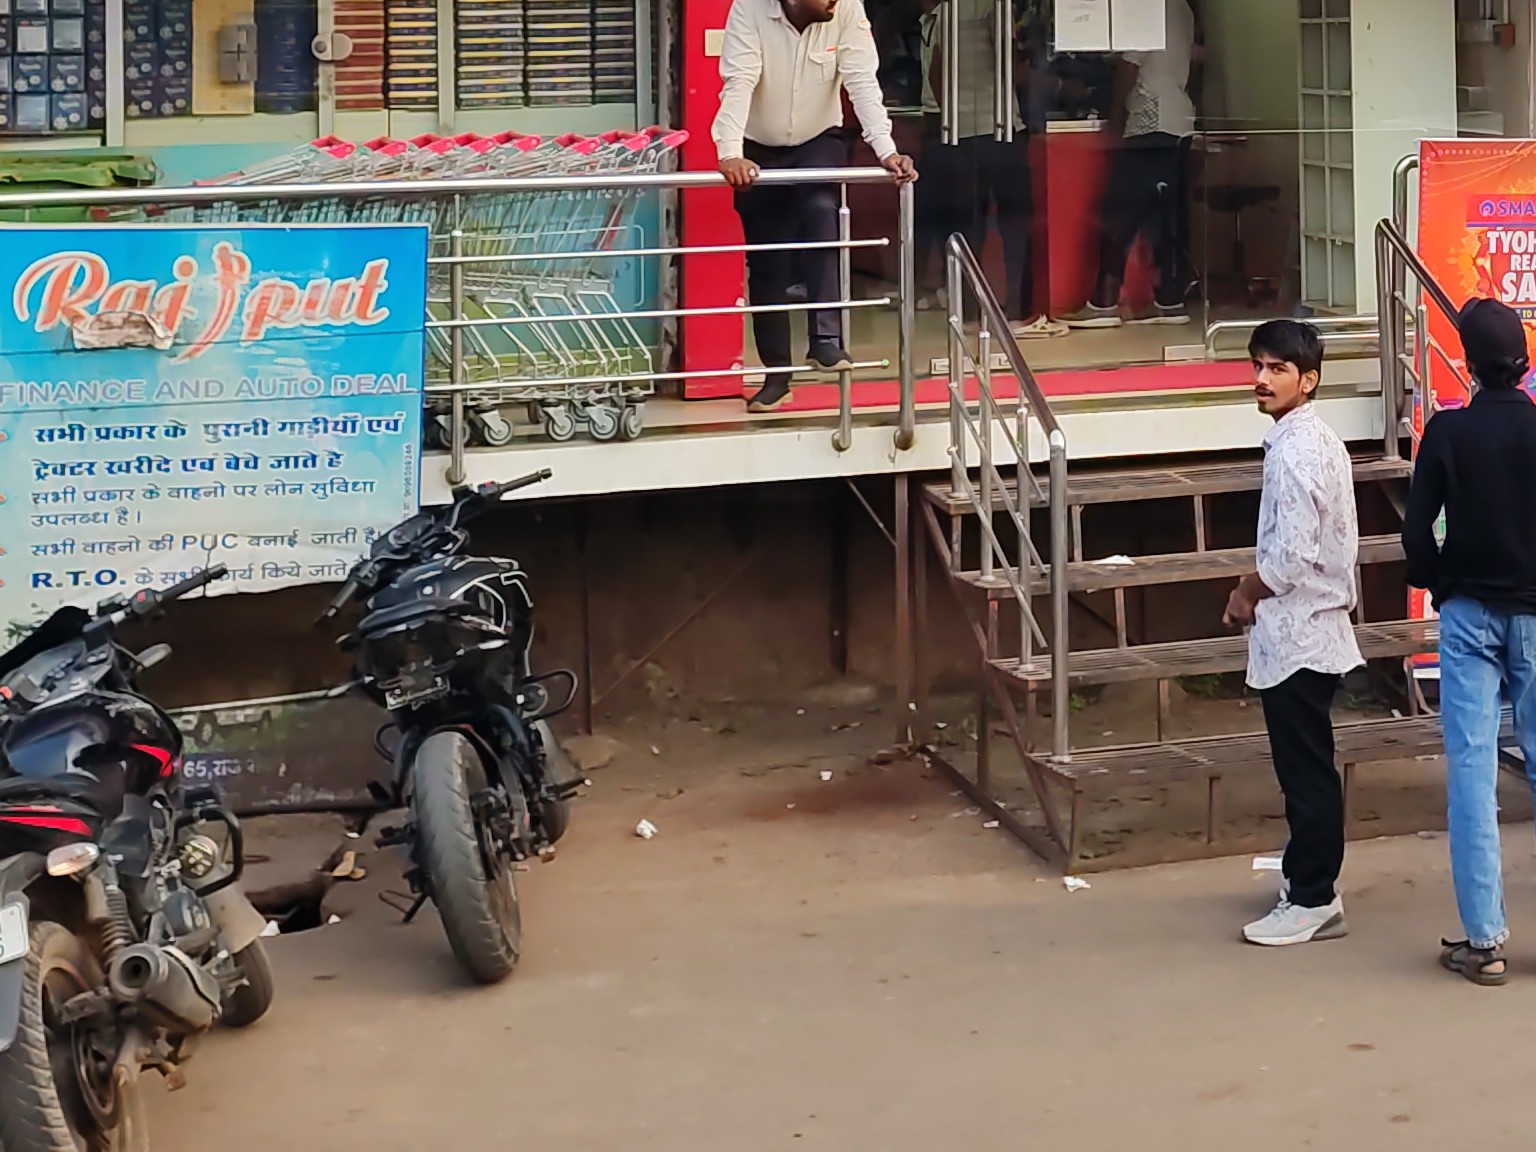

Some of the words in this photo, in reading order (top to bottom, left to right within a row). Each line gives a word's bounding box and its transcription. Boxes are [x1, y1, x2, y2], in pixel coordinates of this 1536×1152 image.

[0, 379, 145, 405] FINANCE
[155, 379, 225, 401] AND
[235, 376, 322, 397] AUTO
[331, 373, 419, 395] DEAL
[34, 423, 87, 443] सभी
[94, 424, 158, 442] प्रकार
[162, 419, 188, 439] के
[203, 417, 270, 444] पुरानी
[268, 450, 320, 470] जाते
[31, 485, 76, 505] सभी
[83, 488, 136, 504] प्रकार
[141, 482, 161, 500] के
[233, 484, 258, 497] पर
[263, 478, 305, 496] लोन
[310, 476, 376, 500] सुविधा
[30, 511, 109, 528] उपलब्ध
[31, 537, 76, 557] सभी
[147, 533, 175, 551] की
[182, 532, 239, 552] PUC
[311, 527, 358, 545] जाती
[31, 568, 127, 589] R.T.O.
[135, 566, 155, 585] के
[261, 561, 302, 580] किये
[308, 558, 348, 577] जाते
